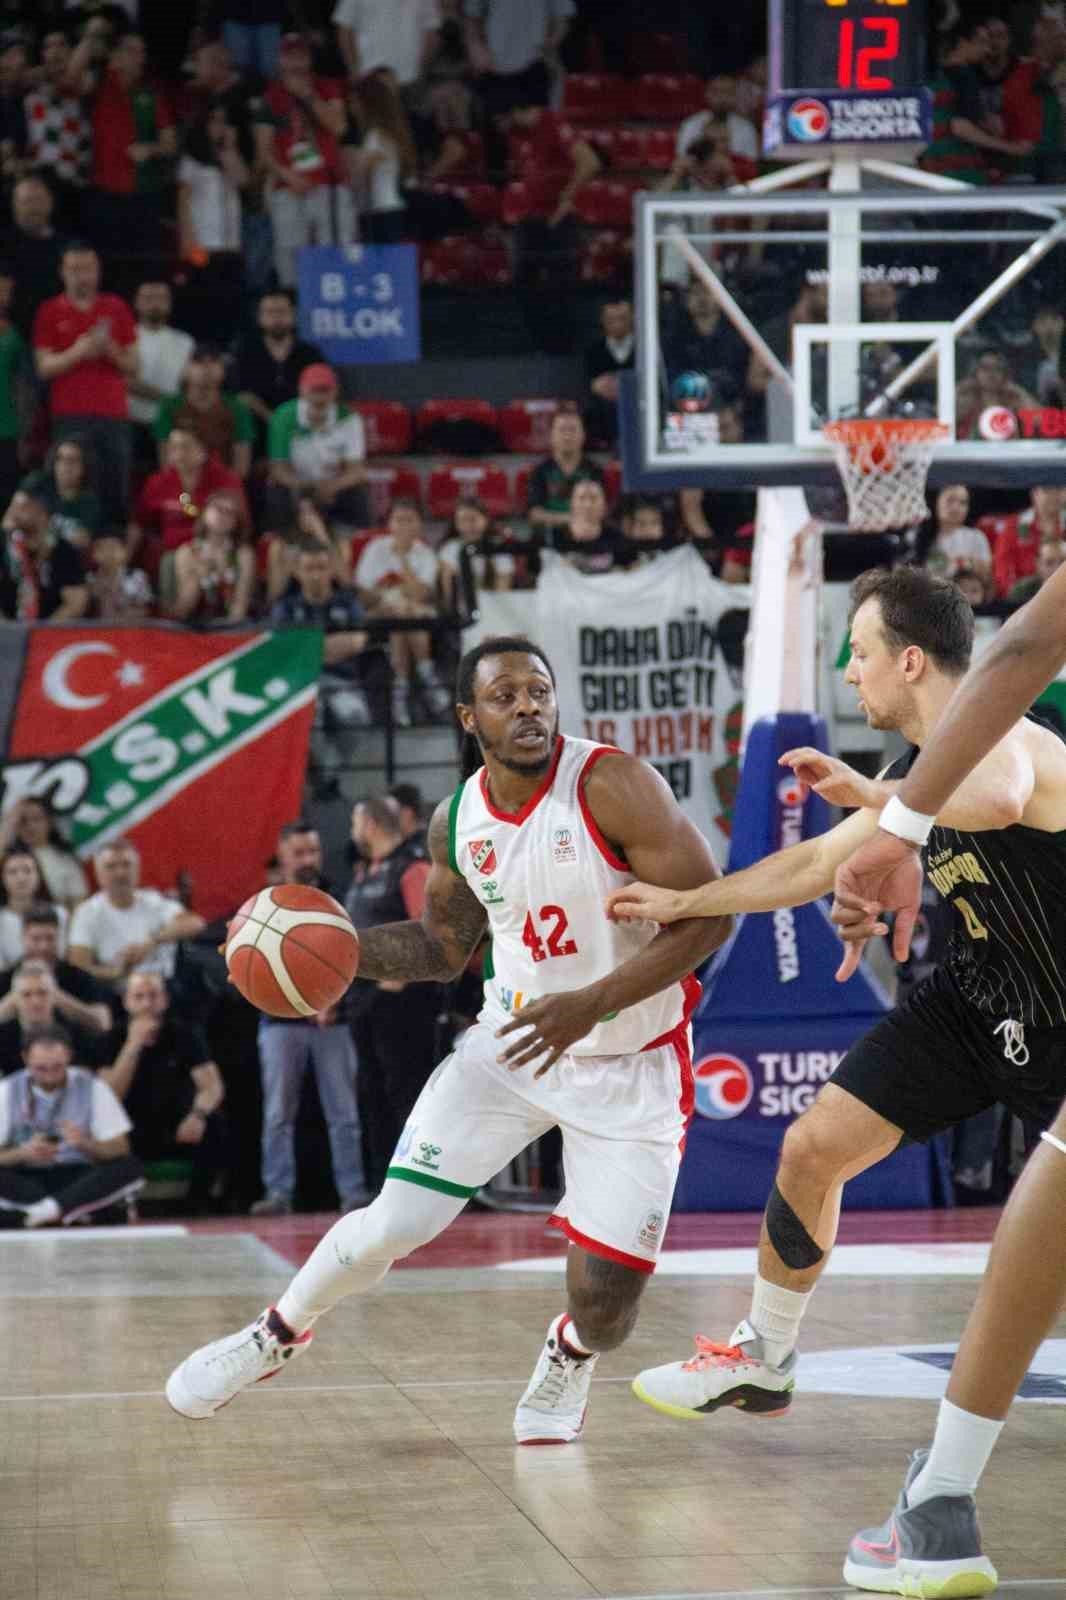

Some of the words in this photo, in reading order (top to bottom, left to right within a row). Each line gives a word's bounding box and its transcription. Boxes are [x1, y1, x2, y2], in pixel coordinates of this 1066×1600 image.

[837, 17, 900, 91] 12
[310, 307, 404, 339] BLOK
[579, 625, 660, 667] DAHA
[522, 904, 578, 963] 42
